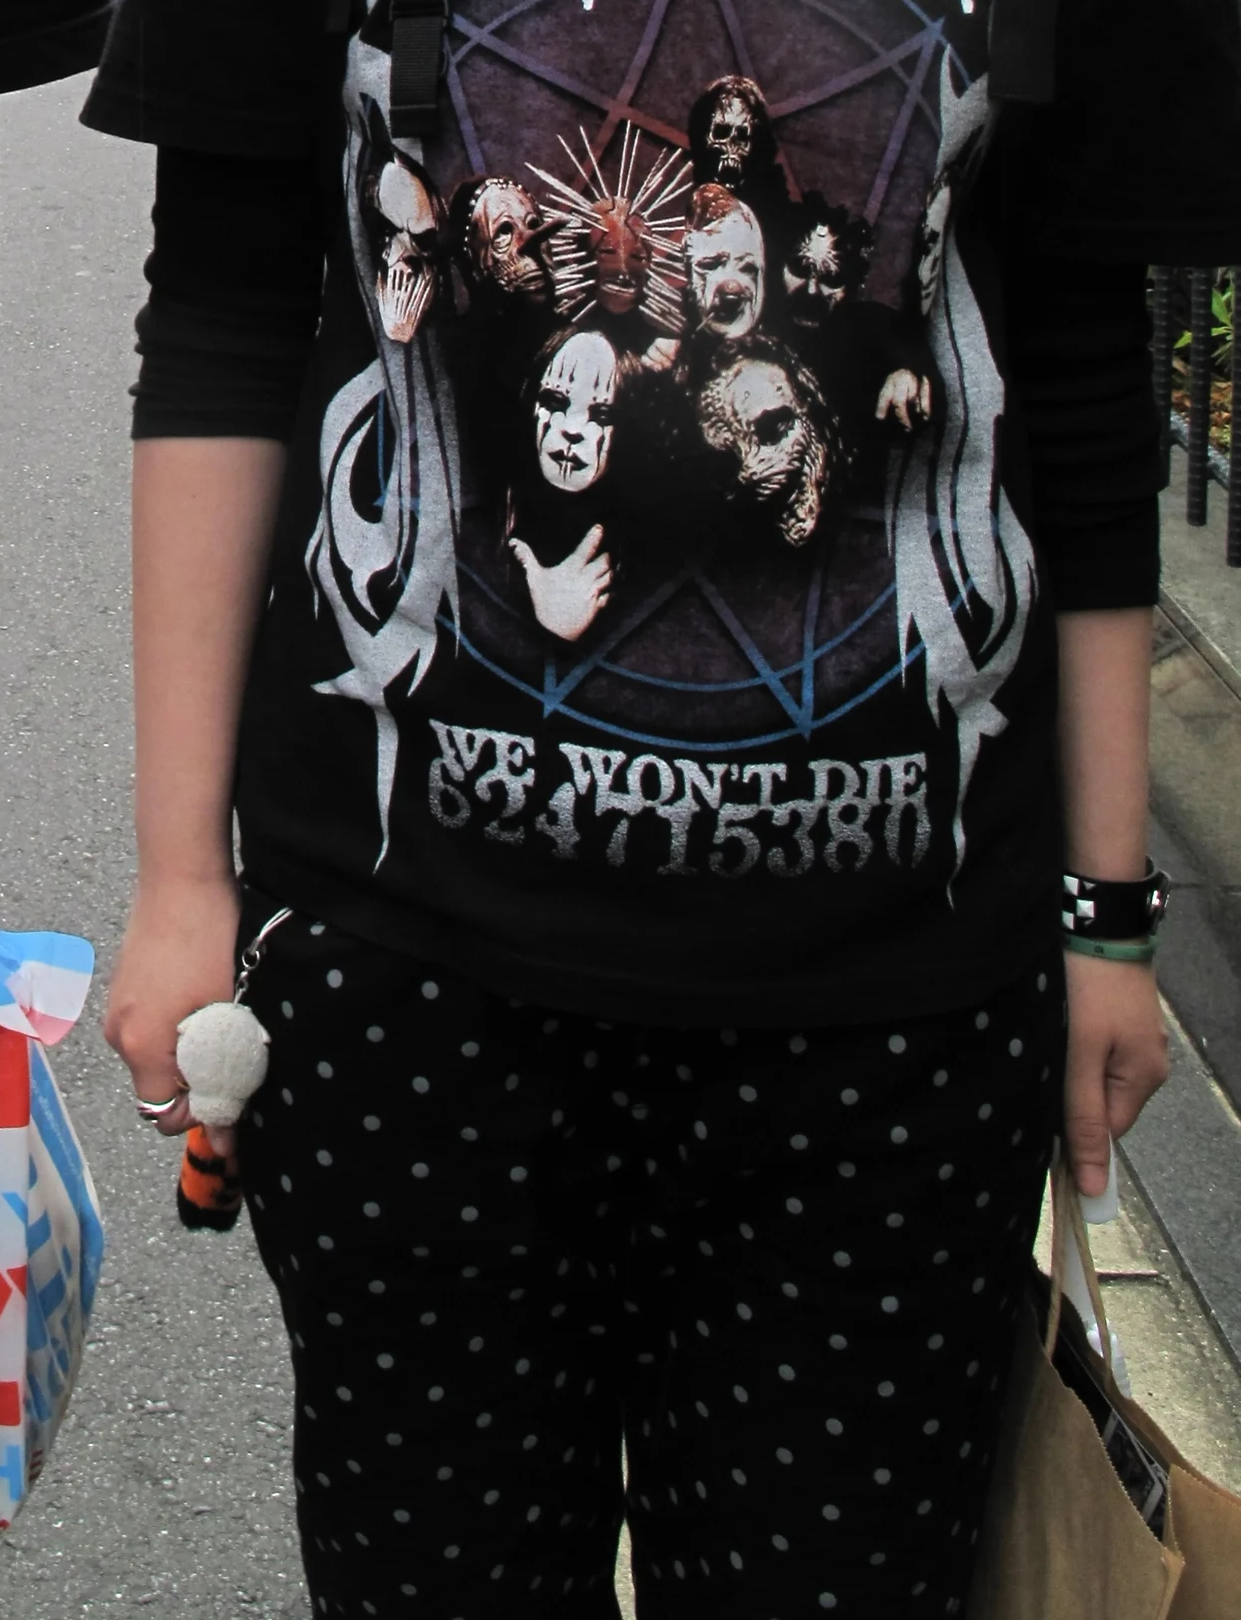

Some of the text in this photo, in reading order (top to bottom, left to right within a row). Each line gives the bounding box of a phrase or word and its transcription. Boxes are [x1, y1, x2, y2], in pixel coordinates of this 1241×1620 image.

[429, 719, 927, 818] WE WON'T DIE
